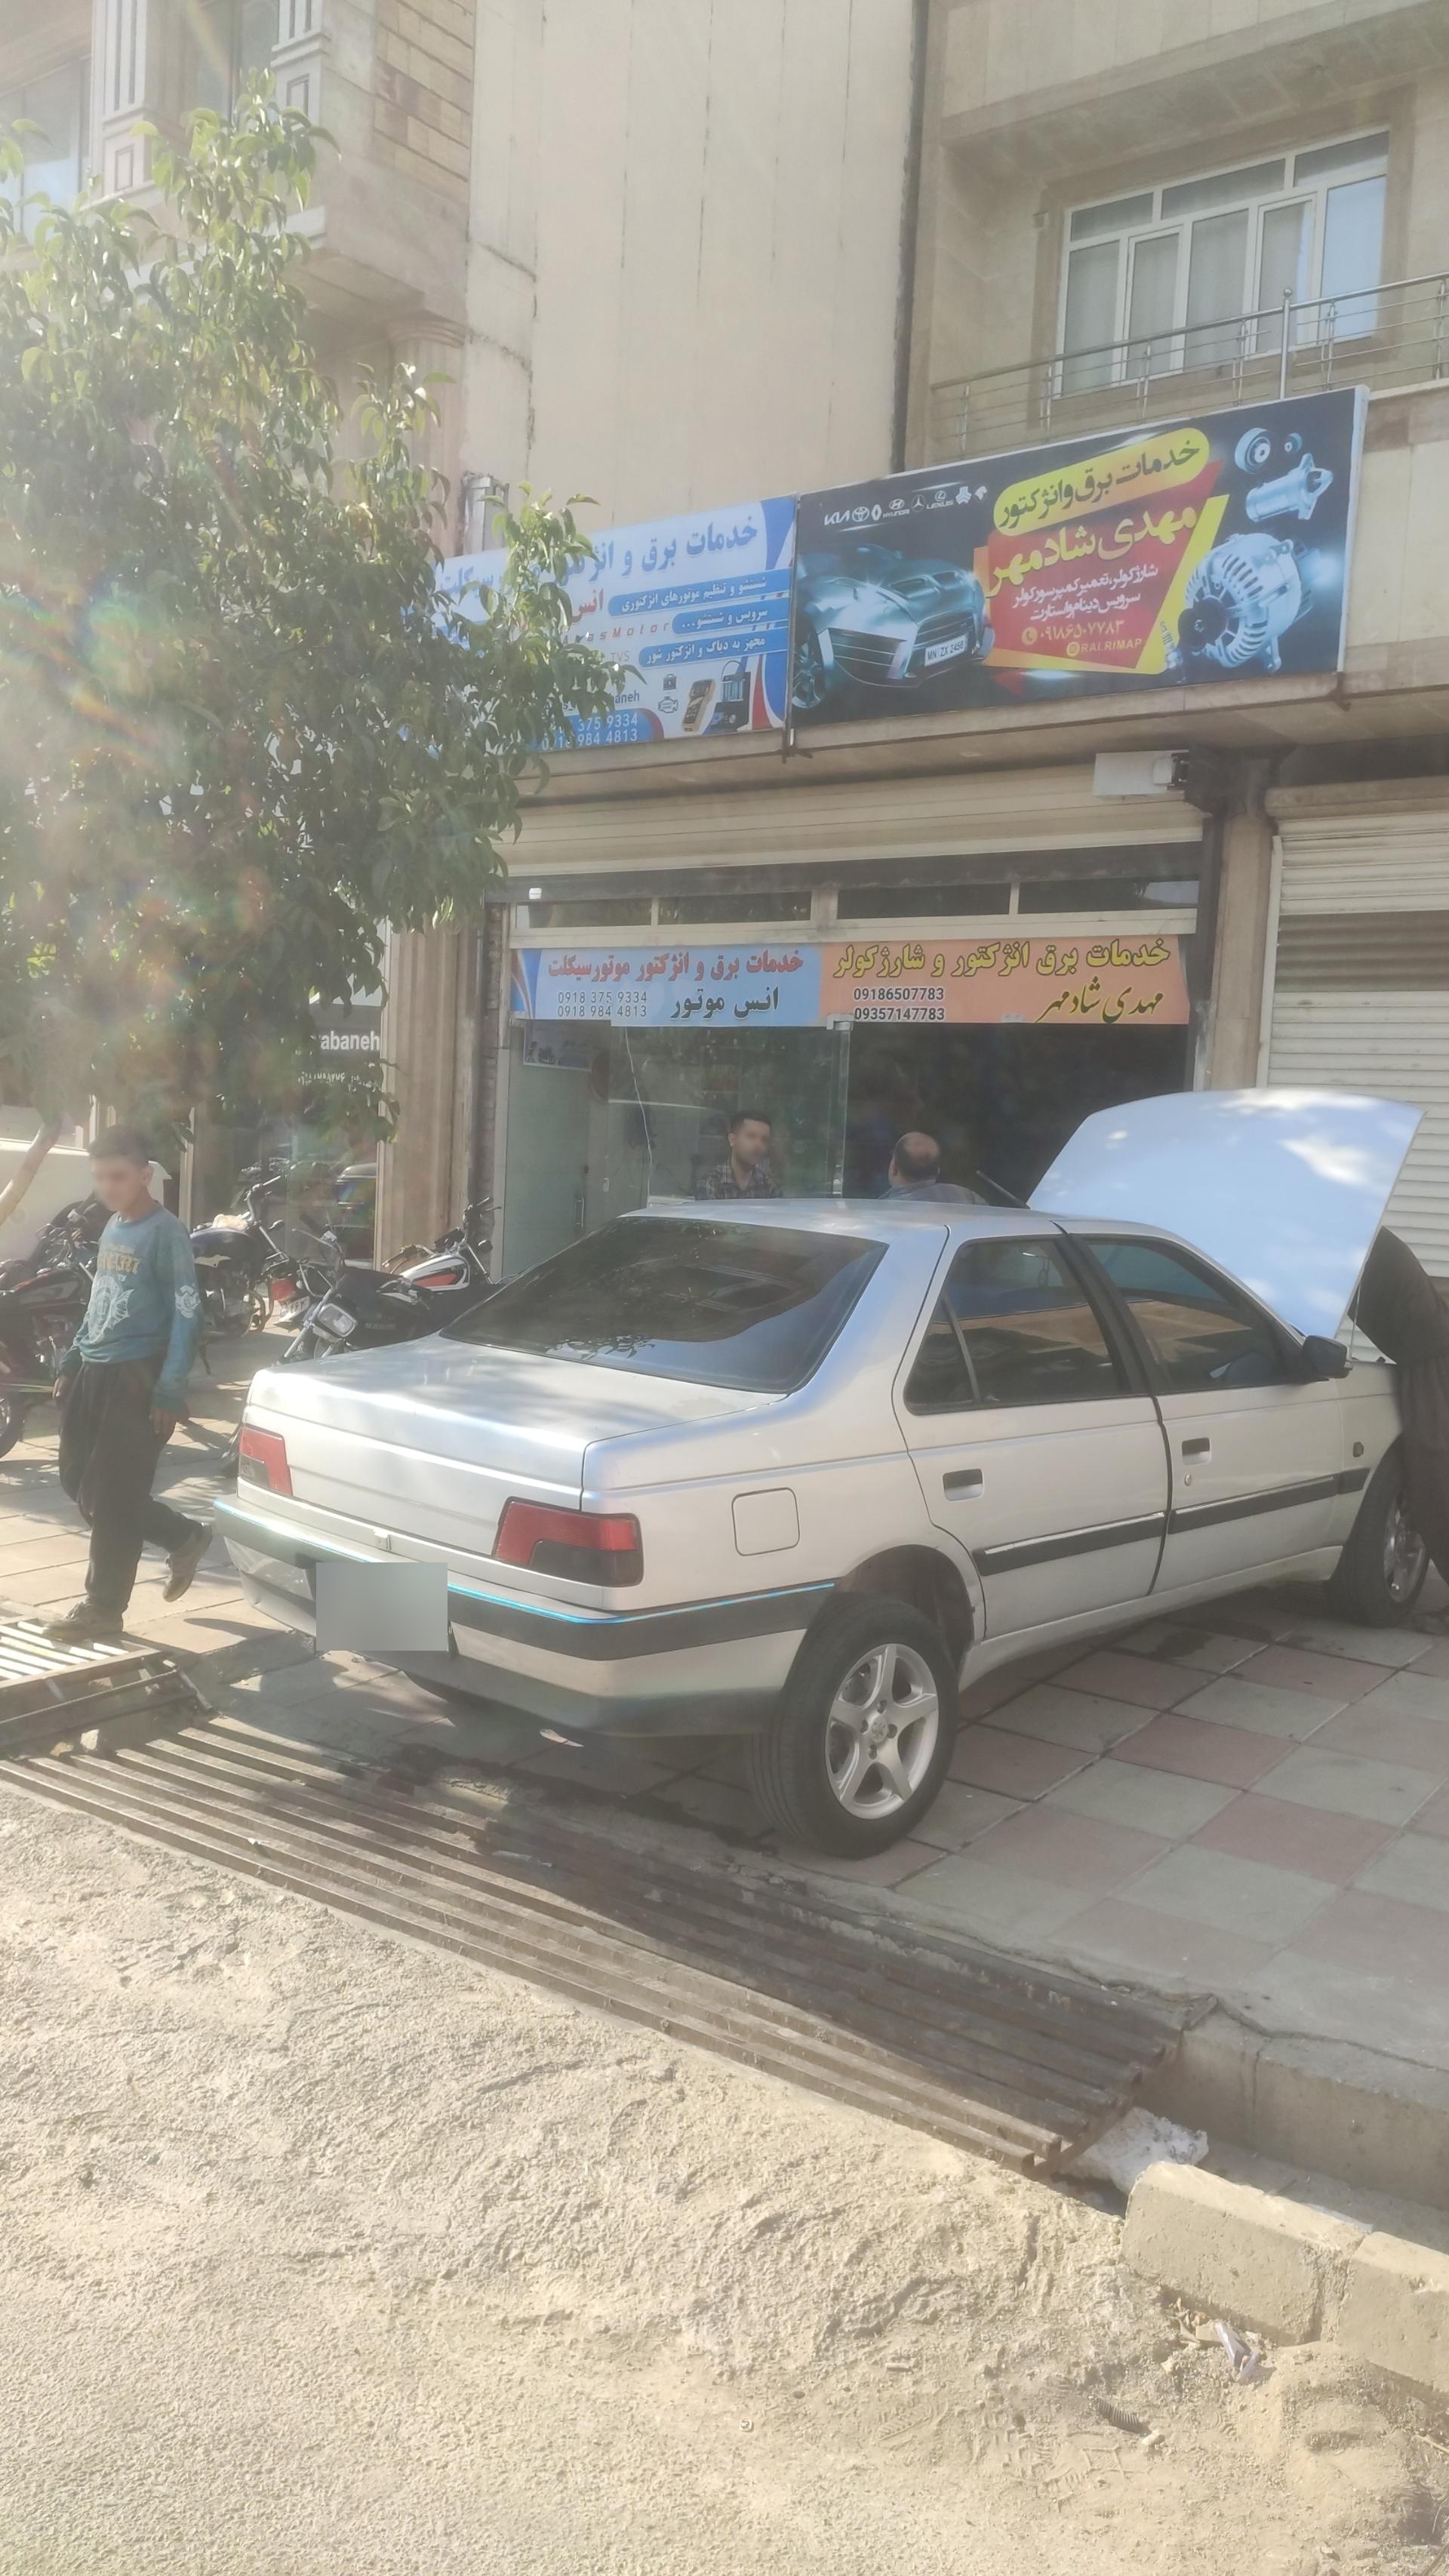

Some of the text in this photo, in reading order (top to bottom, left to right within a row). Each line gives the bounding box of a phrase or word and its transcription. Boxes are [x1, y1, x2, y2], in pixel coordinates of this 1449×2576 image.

[1116, 440, 1201, 485] خدمات
[1075, 468, 1112, 503] برق
[998, 479, 1063, 528] انژکتور
[686, 516, 758, 556] خدمات
[642, 537, 676, 572] برق
[985, 506, 1198, 598] مهدی شادمهر
[622, 550, 632, 576] و
[703, 582, 727, 599] تنظیم
[730, 586, 735, 596] و
[738, 576, 767, 595] شستشو
[728, 614, 733, 625] و
[736, 608, 768, 623] سرویس
[732, 639, 740, 650] به
[744, 636, 766, 651] مجهز
[578, 712, 638, 731] 375 9334
[577, 732, 600, 746] 984
[606, 729, 638, 743] 4813
[635, 951, 689, 982] انژکتور
[710, 955, 740, 980] برق
[746, 949, 804, 973] خدمات
[833, 937, 1171, 978] خدمات برق انژکتور و شارژ کولر
[694, 960, 705, 981] و
[558, 990, 648, 1004] 0918 375 9334
[671, 986, 779, 1019] انس موتور
[854, 987, 944, 1001] 09186507783
[1035, 975, 1164, 1023] مهدی شادمهر
[557, 1005, 647, 1017] 0918 984 4813
[854, 1008, 945, 1020] 09357147783
[318, 1030, 380, 1051] abaneh
